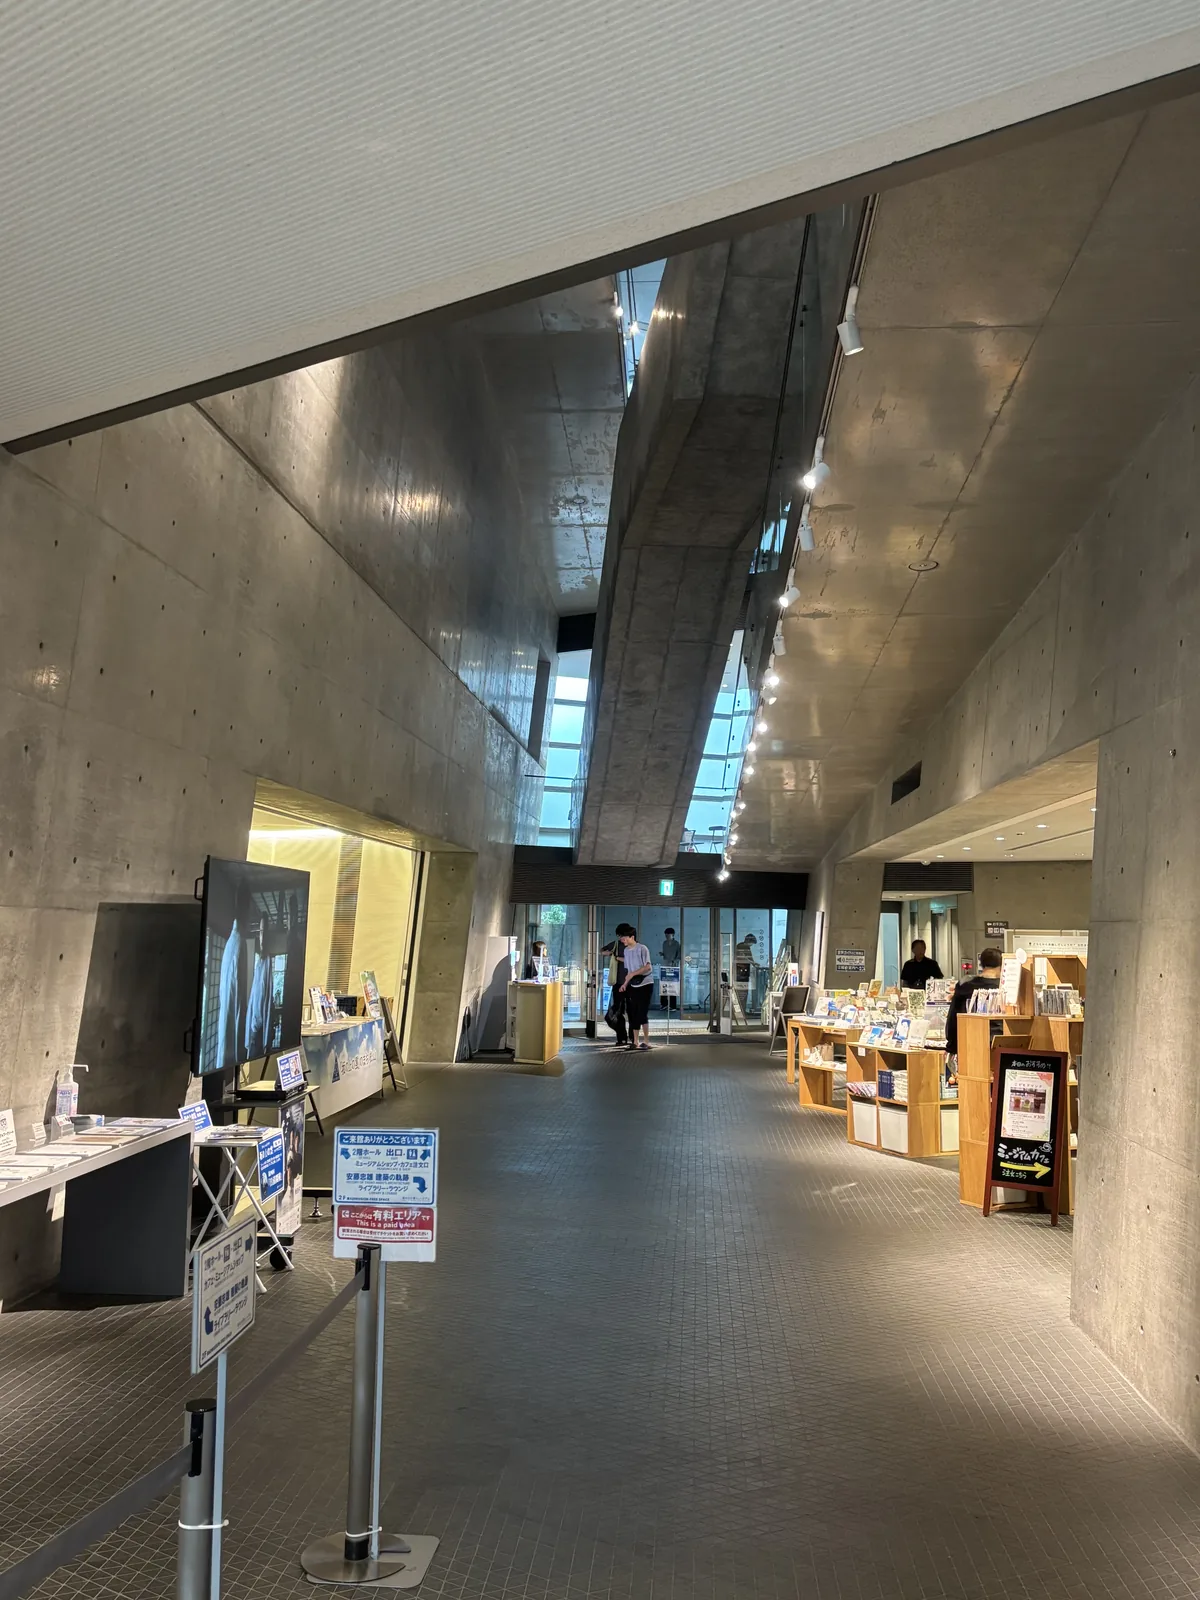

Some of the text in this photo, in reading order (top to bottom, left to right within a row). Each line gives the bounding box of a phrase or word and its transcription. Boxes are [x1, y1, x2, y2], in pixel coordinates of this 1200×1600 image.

[342, 1135, 429, 1144] ご来館ありがとうございます。
[997, 1142, 1051, 1164] ミュージアムカフェ
[356, 1219, 369, 1227] This
[383, 1221, 398, 1229] paid
